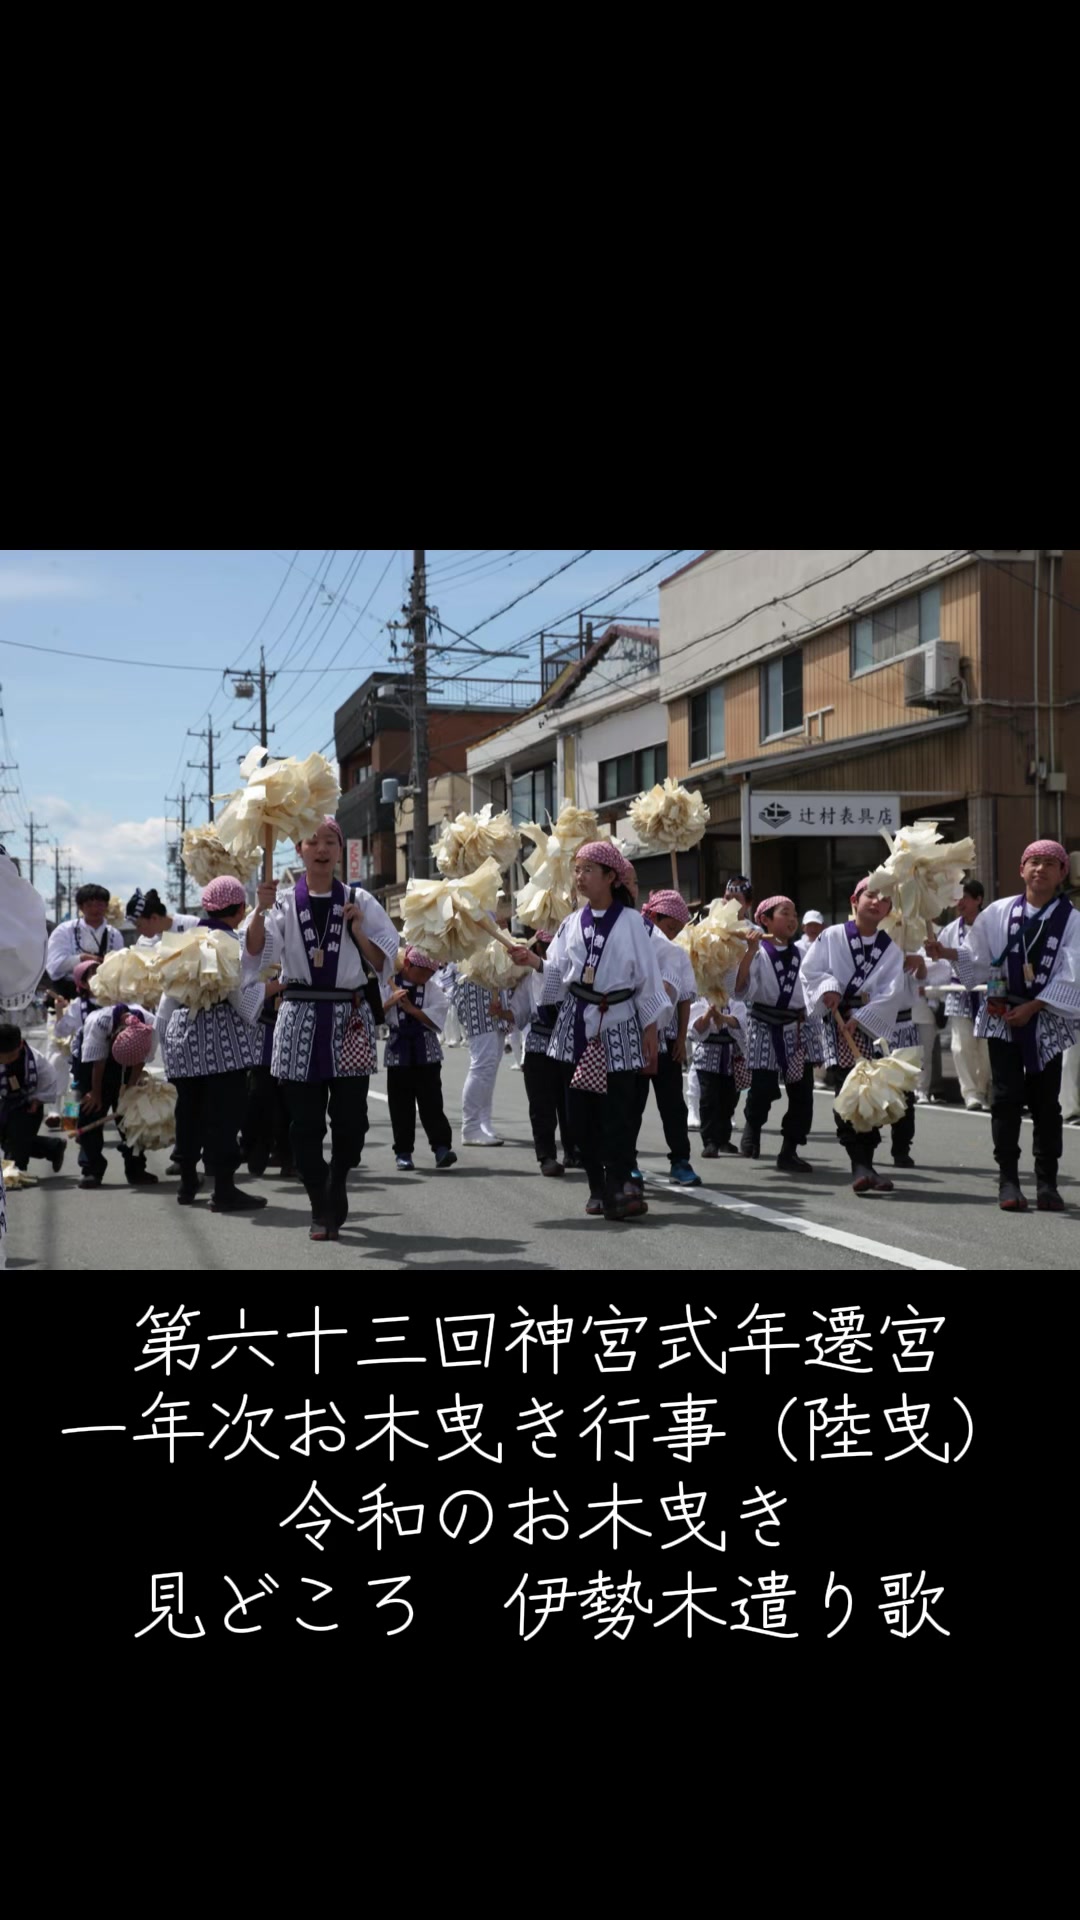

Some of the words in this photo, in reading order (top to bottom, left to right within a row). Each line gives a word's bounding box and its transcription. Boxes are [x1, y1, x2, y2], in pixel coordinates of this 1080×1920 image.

[798, 805, 893, 826] 辻村表具店
